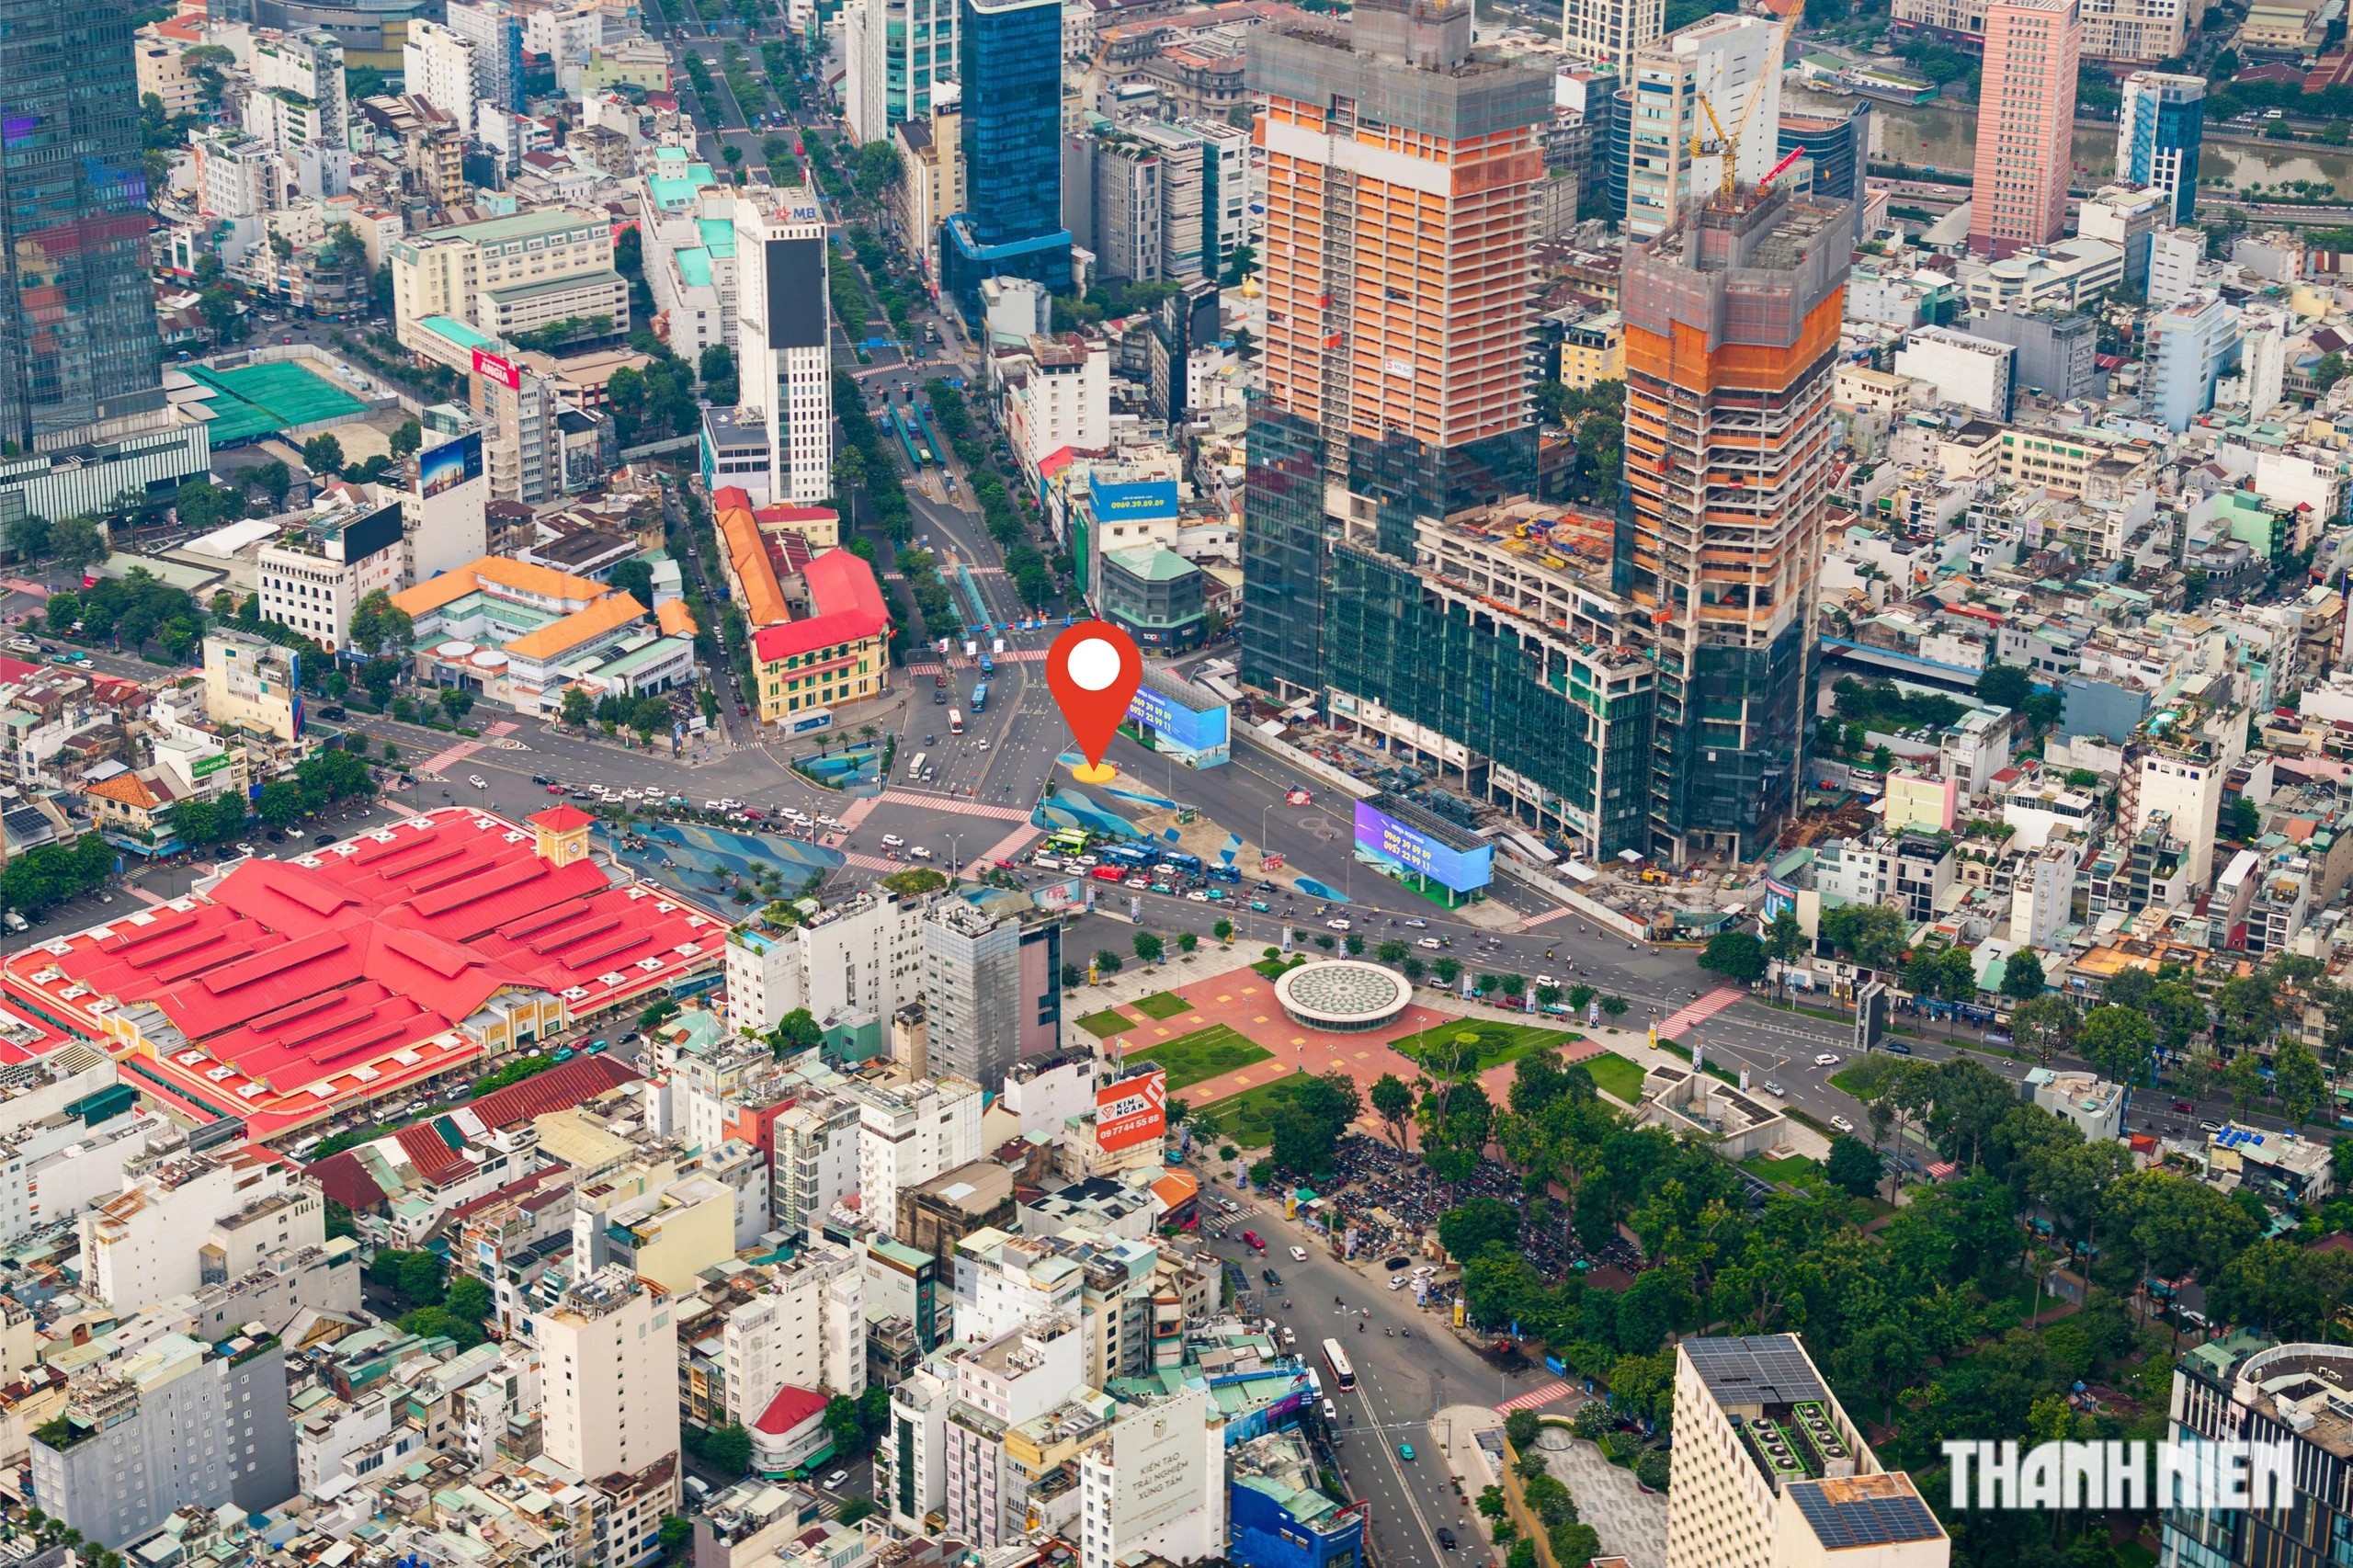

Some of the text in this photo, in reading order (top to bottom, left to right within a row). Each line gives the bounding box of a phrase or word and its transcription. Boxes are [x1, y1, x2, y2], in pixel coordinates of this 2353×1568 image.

[793, 207, 816, 220] MB
[1116, 1098, 1135, 1110] KIM
[1116, 1102, 1144, 1117] NGAN
